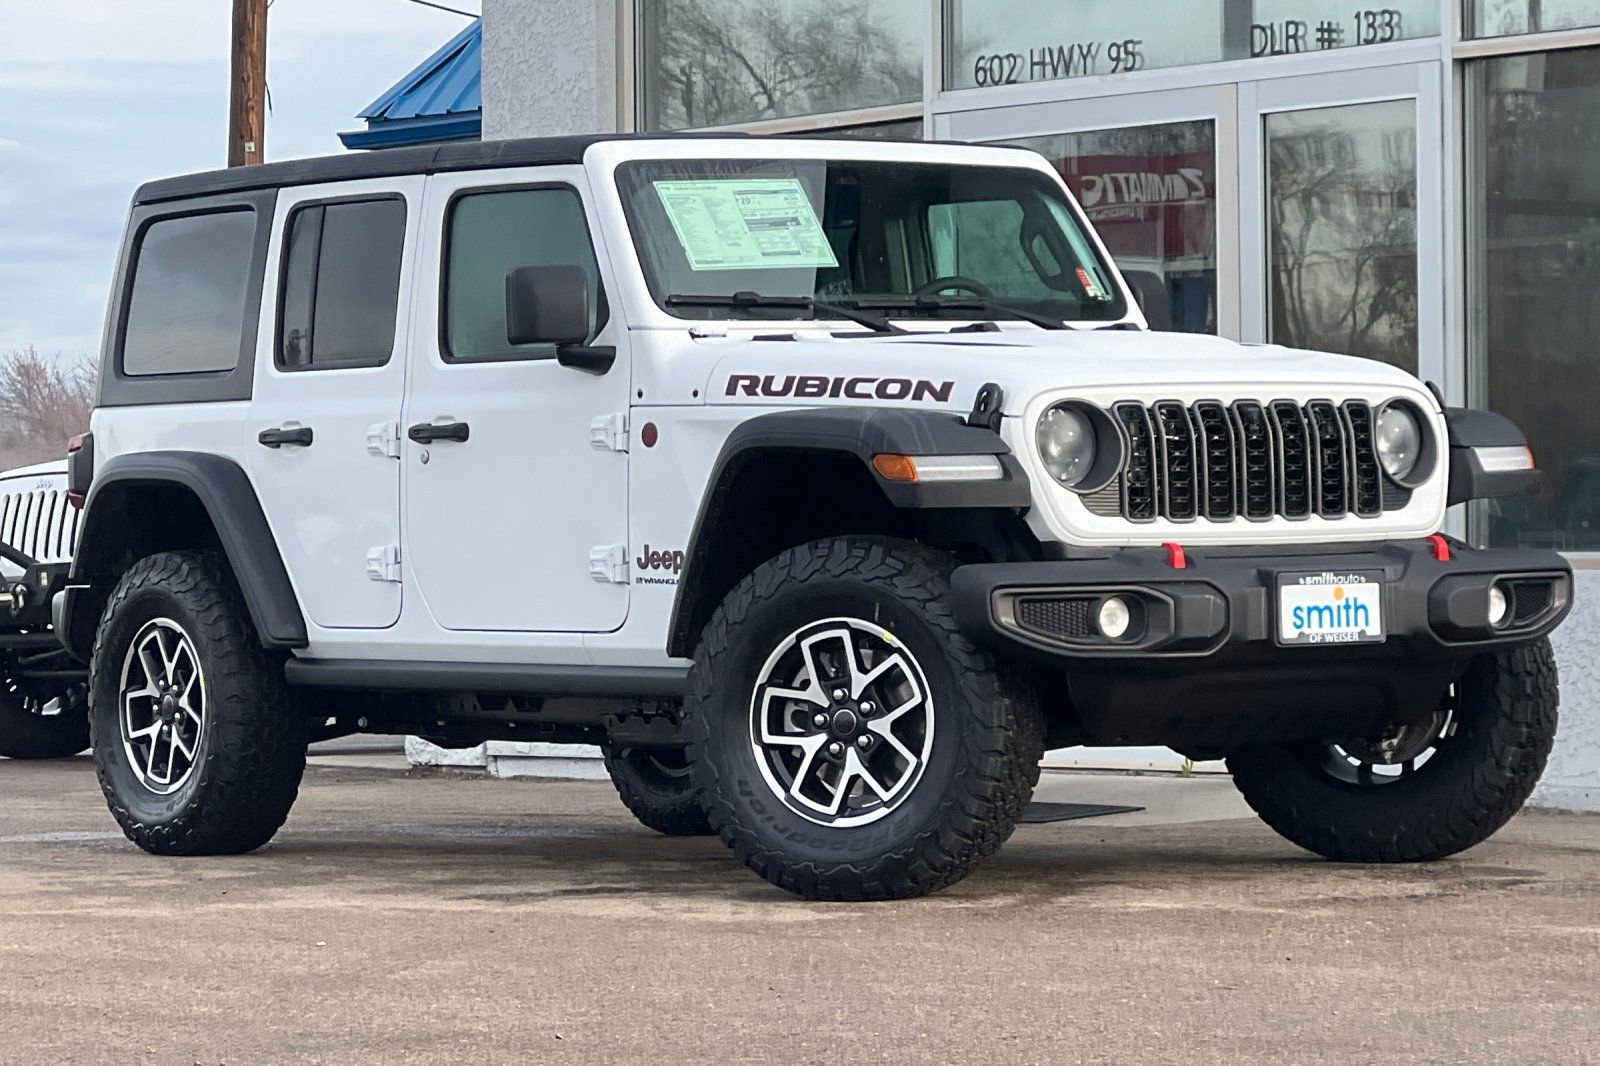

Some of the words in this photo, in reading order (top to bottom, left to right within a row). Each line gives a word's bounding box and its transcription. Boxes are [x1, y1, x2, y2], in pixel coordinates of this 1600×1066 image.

[1250, 20, 1301, 58] DLR
[1354, 9, 1396, 46] 133
[974, 53, 1017, 87] 602
[1030, 43, 1093, 80] HWY
[1107, 39, 1137, 73] 95
[725, 374, 955, 403] RUBICON
[636, 543, 685, 575] Jeep
[1305, 572, 1360, 584] smithauto
[1292, 586, 1370, 630] smith
[1309, 633, 1323, 643] OF
[1324, 631, 1359, 643] WEISER
